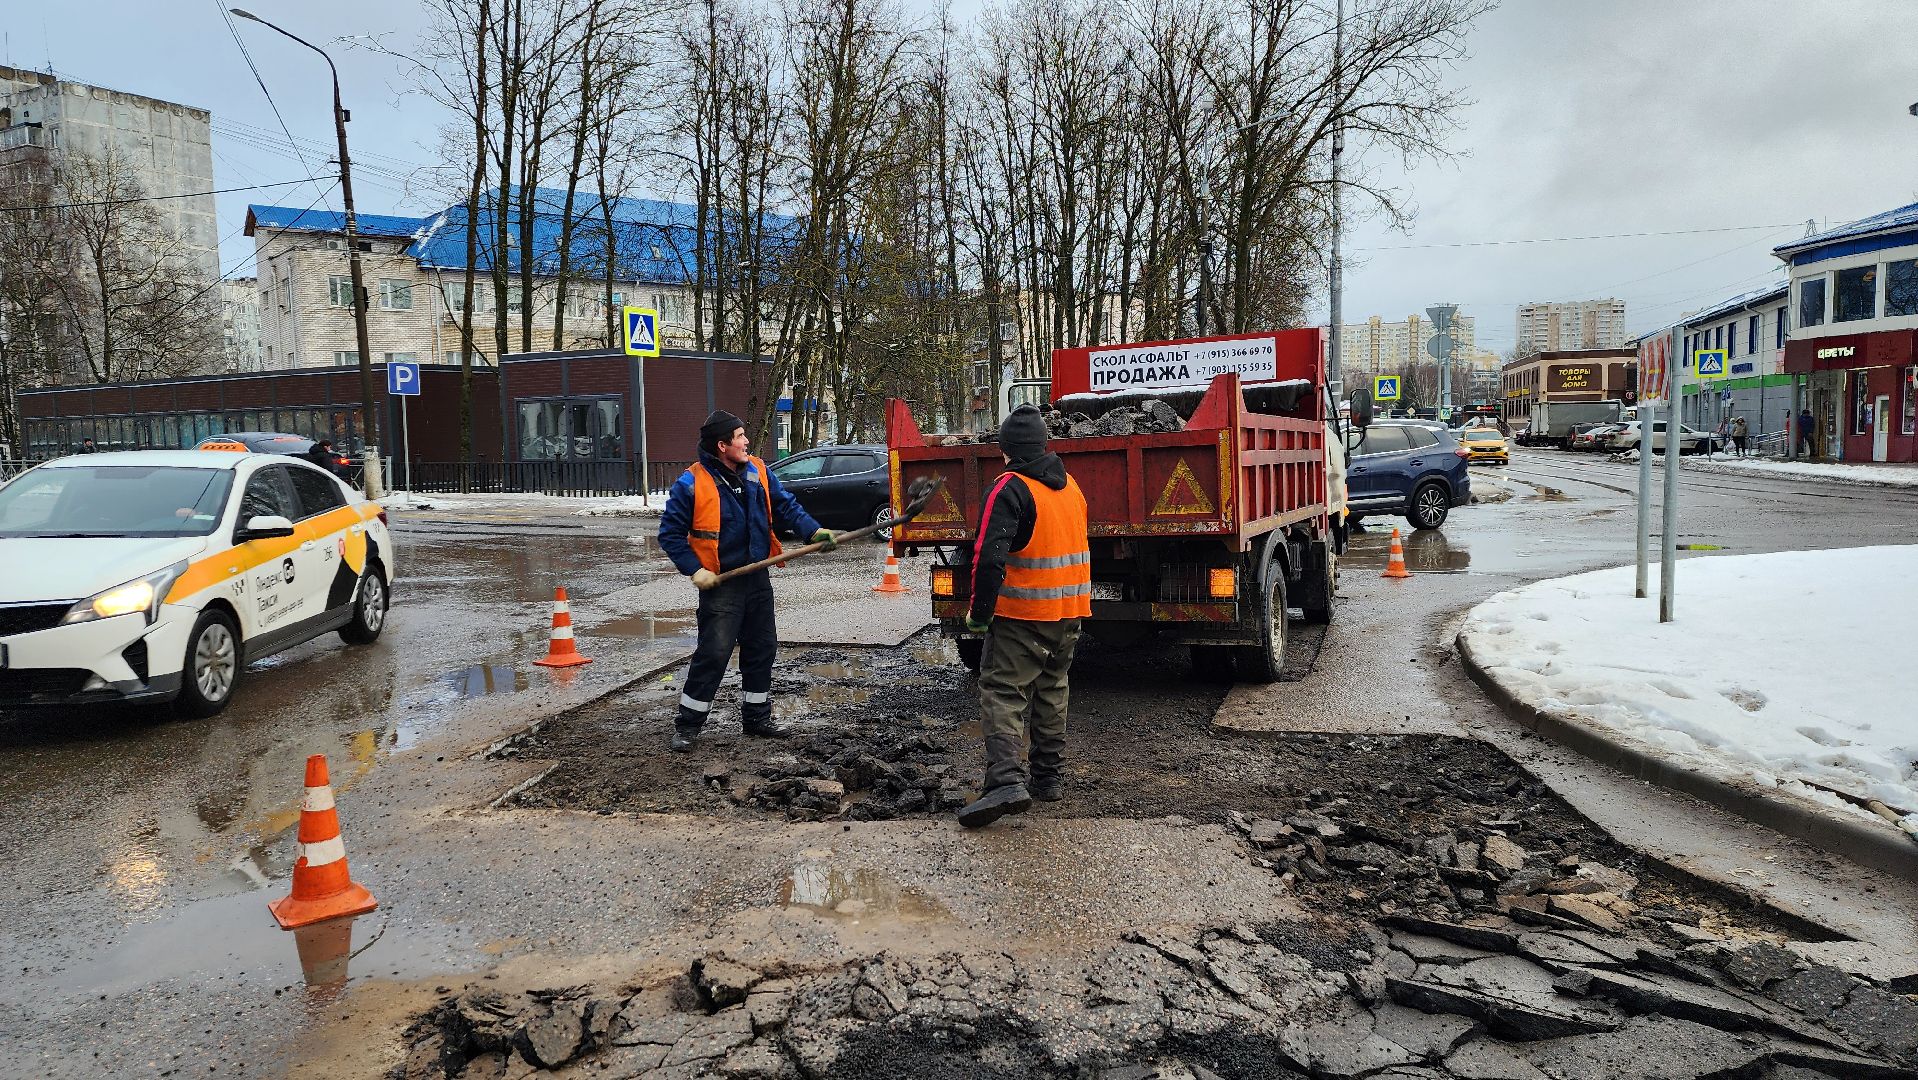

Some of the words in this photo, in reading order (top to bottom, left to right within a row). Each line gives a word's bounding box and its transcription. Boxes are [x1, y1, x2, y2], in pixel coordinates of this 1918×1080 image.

[1093, 355, 1126, 367] СКОЛ
[1130, 350, 1190, 364] АСФАЛЬТ
[1207, 349, 1230, 360] (915)
[1231, 347, 1248, 357] 366
[1249, 346, 1260, 355] 69
[1262, 346, 1272, 355] 70
[1817, 346, 1856, 360] ЦВЕТЫ
[1093, 364, 1190, 386] ПРОДАЖА
[1195, 366, 1207, 375] +7
[1208, 364, 1230, 375] (903)
[1231, 363, 1248, 373] 155
[1249, 362, 1260, 372] 59
[1261, 361, 1272, 371] 35
[395, 365, 413, 391] P
